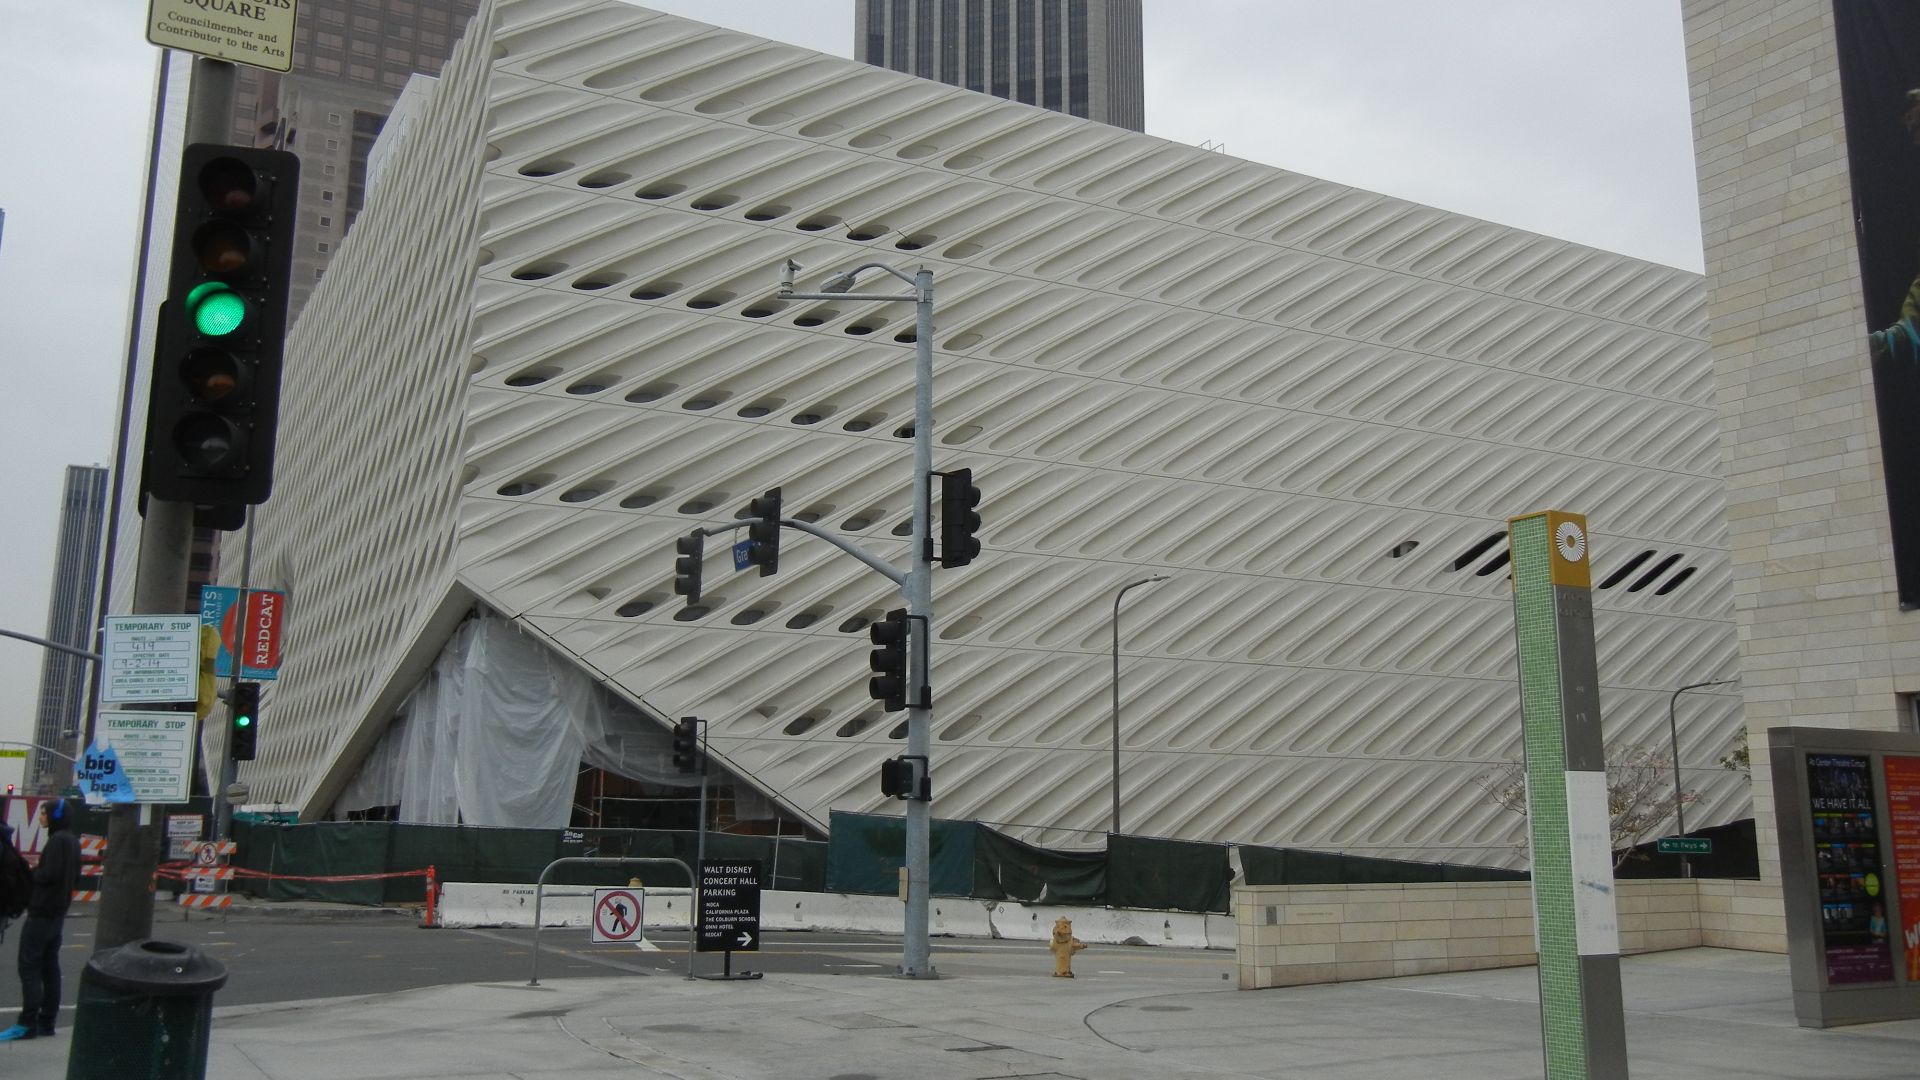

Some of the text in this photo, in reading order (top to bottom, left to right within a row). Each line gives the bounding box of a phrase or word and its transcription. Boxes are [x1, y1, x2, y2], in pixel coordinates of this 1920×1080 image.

[167, 10, 277, 43] Councilmember and
[157, 22, 285, 57] Contributor to the Arts
[115, 622, 192, 631] TEMPORARY STOP
[256, 594, 274, 665] REDCAT
[107, 720, 186, 729] TEMPORARY STOP
[85, 754, 116, 775] big
[78, 770, 103, 780] blue
[91, 780, 118, 792] bus
[1812, 797, 1871, 810] WE HAVE IT ALL
[703, 877, 737, 885] CONCERT
